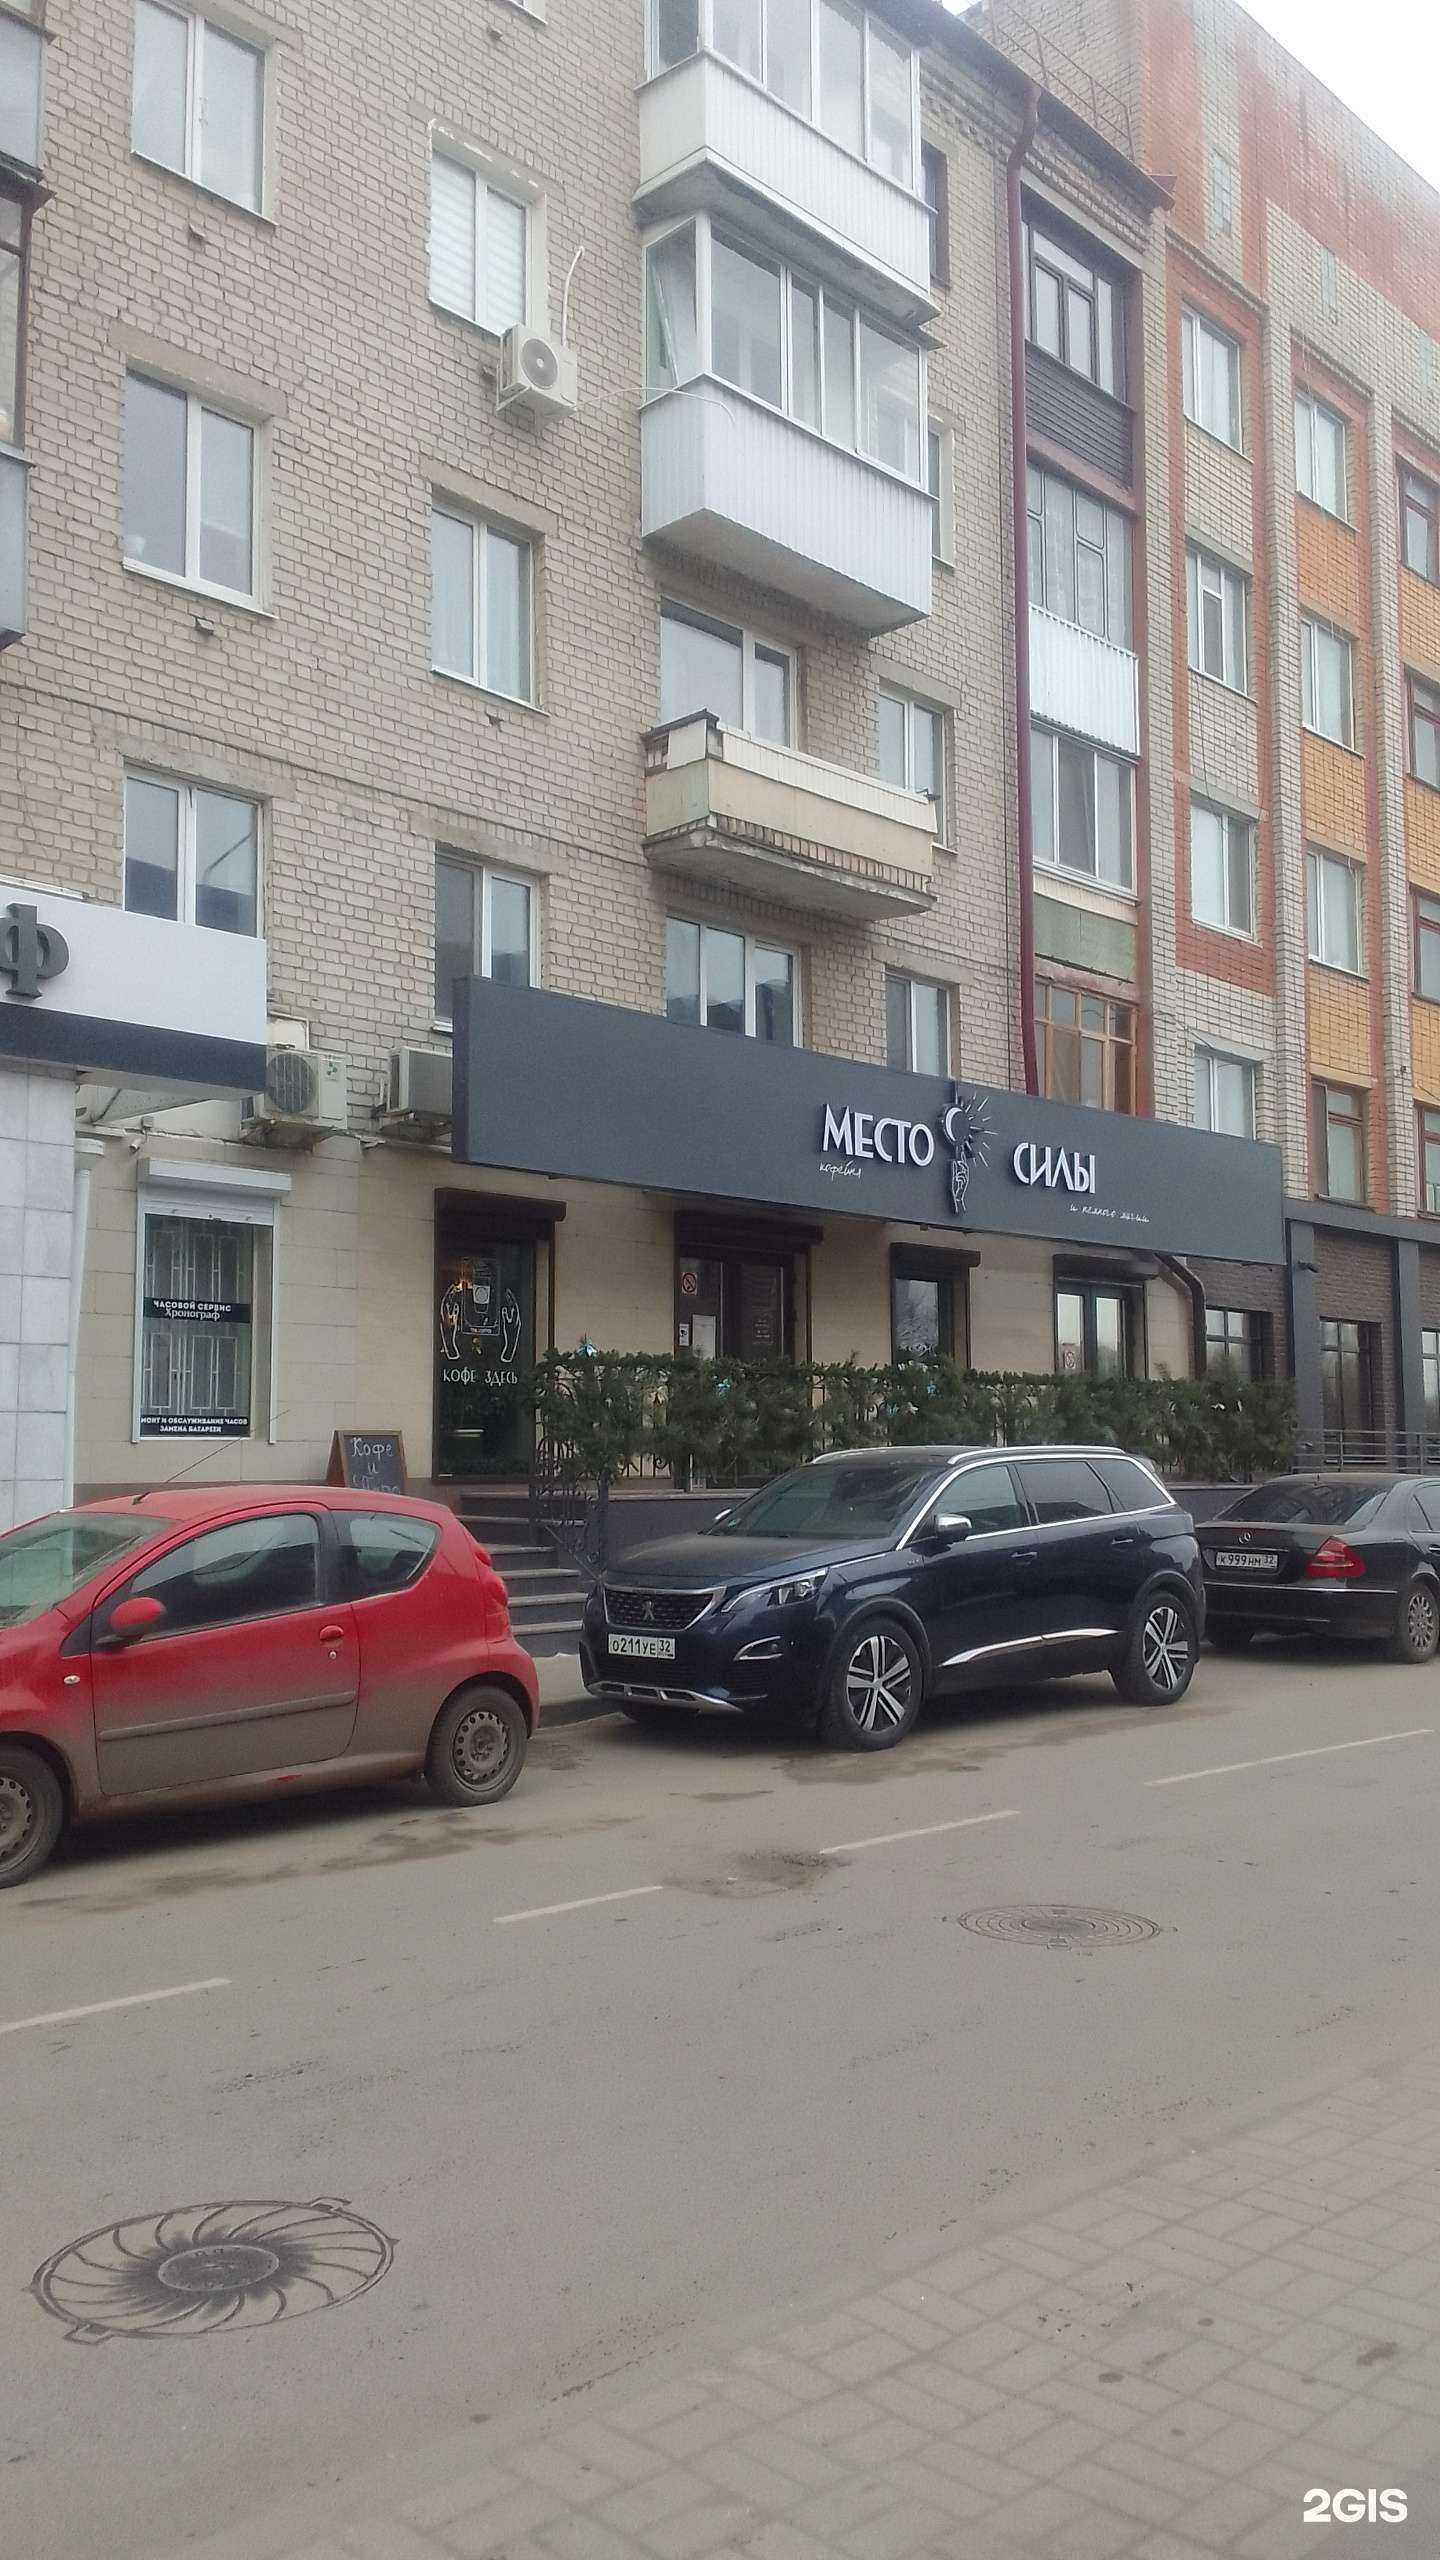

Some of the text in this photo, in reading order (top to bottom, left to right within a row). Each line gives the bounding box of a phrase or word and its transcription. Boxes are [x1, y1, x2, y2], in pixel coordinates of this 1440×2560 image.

[821, 1103, 1097, 1195] МЕСТО СИЛЫ
[153, 1299, 232, 1312] ЧАСОВОЙ СЕРВИС
[164, 1308, 221, 1322] Хронограф
[443, 1366, 518, 1387] КОФЕ ЗДЕСЬ
[159, 1425, 188, 1433] ЗАМЕНА
[225, 1418, 248, 1426] ЧАСОВ
[351, 1437, 394, 1462] Кофе
